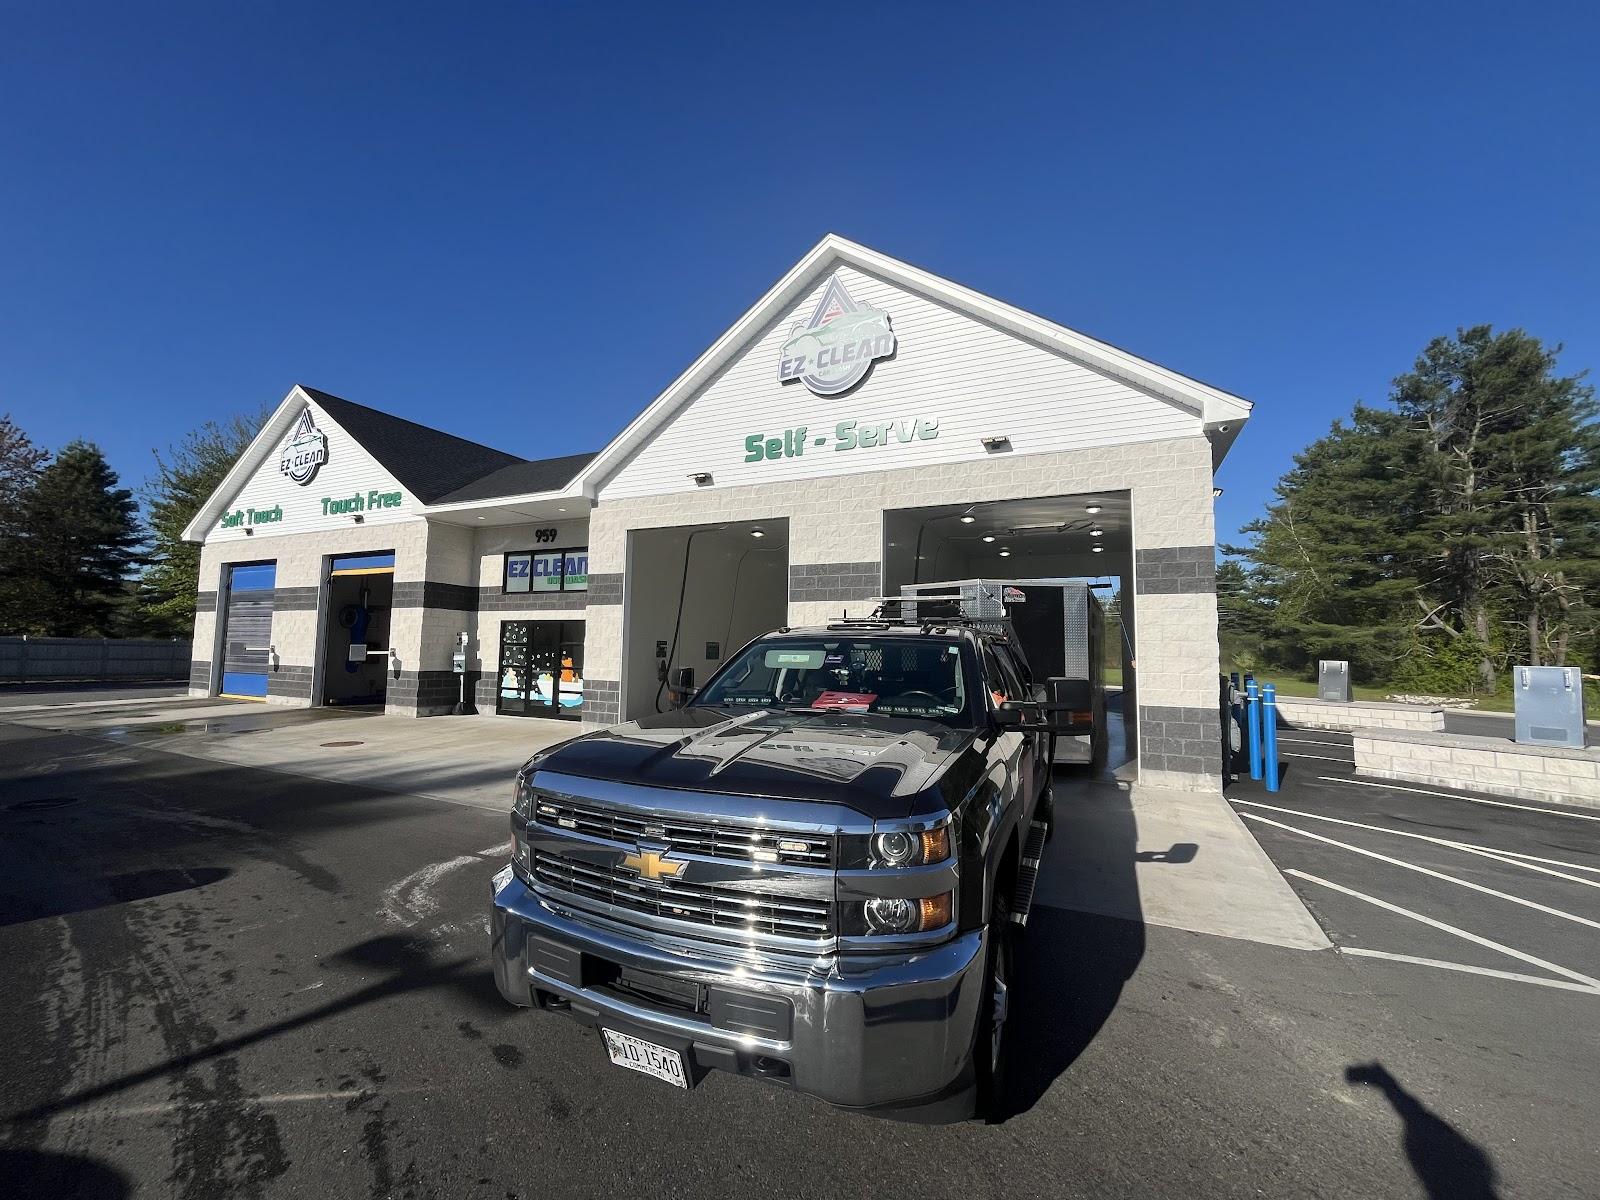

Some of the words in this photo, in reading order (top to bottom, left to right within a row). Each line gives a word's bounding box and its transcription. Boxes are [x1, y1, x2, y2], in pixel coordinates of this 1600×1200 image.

[780, 357, 806, 379] EZ
[816, 334, 891, 369] CLEAN
[744, 427, 808, 463] Self
[834, 415, 939, 451] Serve
[280, 458, 291, 472] EZ
[294, 449, 323, 468] CLEAN
[320, 493, 364, 515] Touch
[367, 490, 402, 511] Free
[220, 509, 245, 528] Soft
[246, 504, 283, 525] Touch
[535, 528, 557, 543] 959
[508, 559, 529, 577] EZ
[533, 556, 588, 577] CLEAN
[628, 1061, 666, 1079] COMMERCIAL
